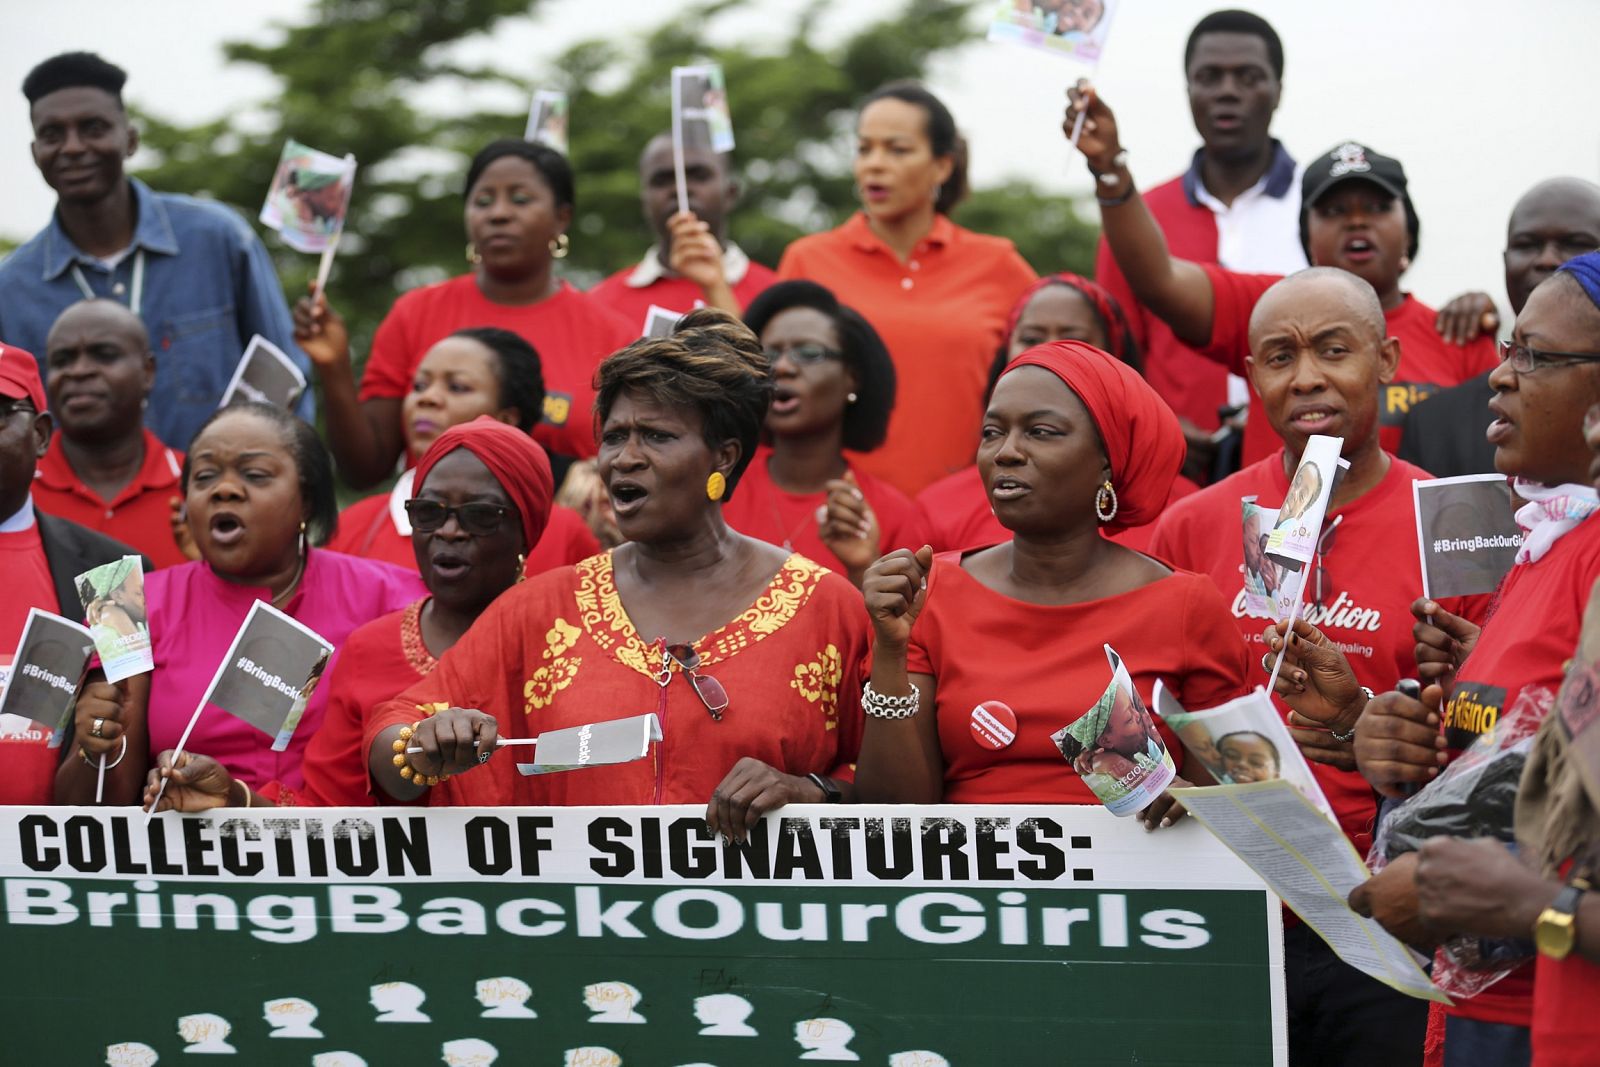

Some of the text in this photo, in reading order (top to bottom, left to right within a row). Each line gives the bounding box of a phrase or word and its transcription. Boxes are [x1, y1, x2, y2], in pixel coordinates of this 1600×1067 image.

[19, 815, 1093, 880] COLLECTION OF SIGNATURES:
[4, 879, 1211, 950] BringBackOurGirls
